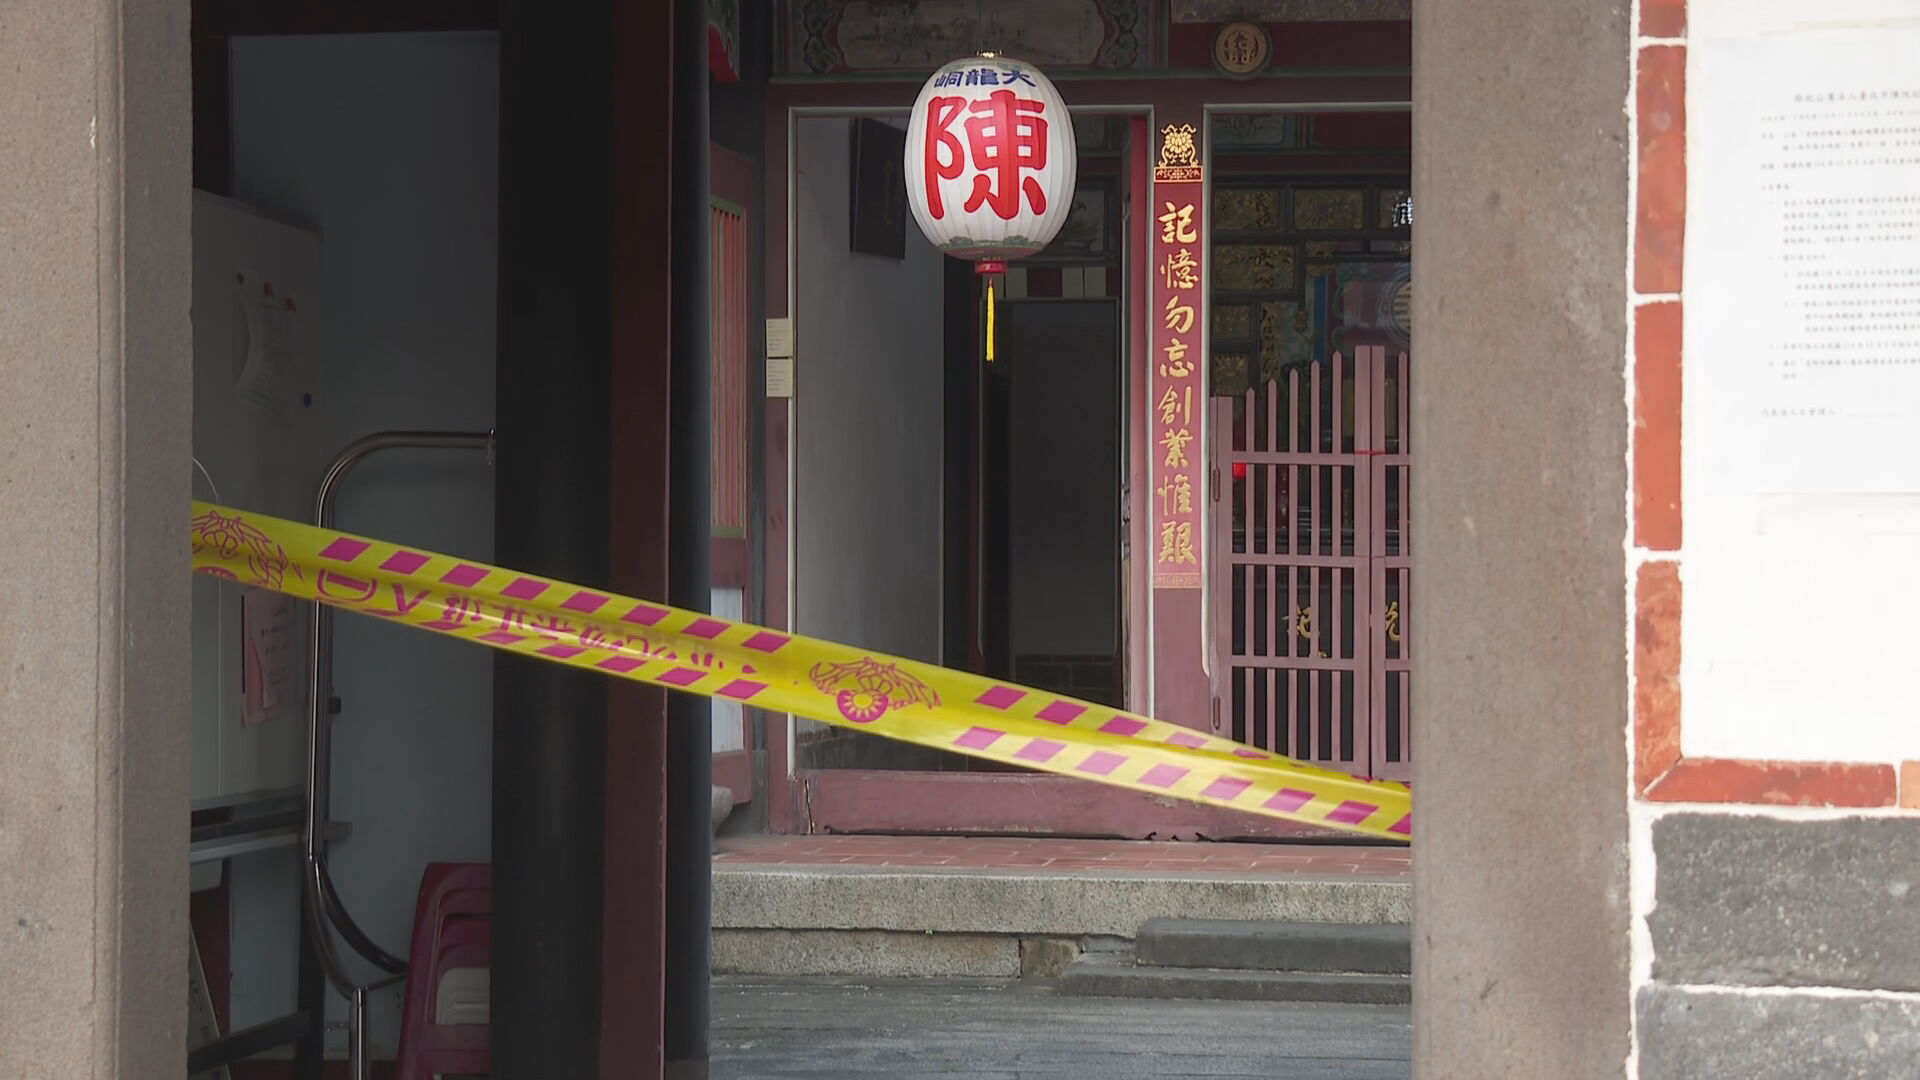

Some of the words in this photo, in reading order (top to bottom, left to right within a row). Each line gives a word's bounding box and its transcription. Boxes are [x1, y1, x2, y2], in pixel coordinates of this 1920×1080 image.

[933, 67, 1036, 89] 大龍峒
[924, 89, 1049, 221] 陳
[1157, 201, 1199, 565] 記憶勿忘創業惟艱
